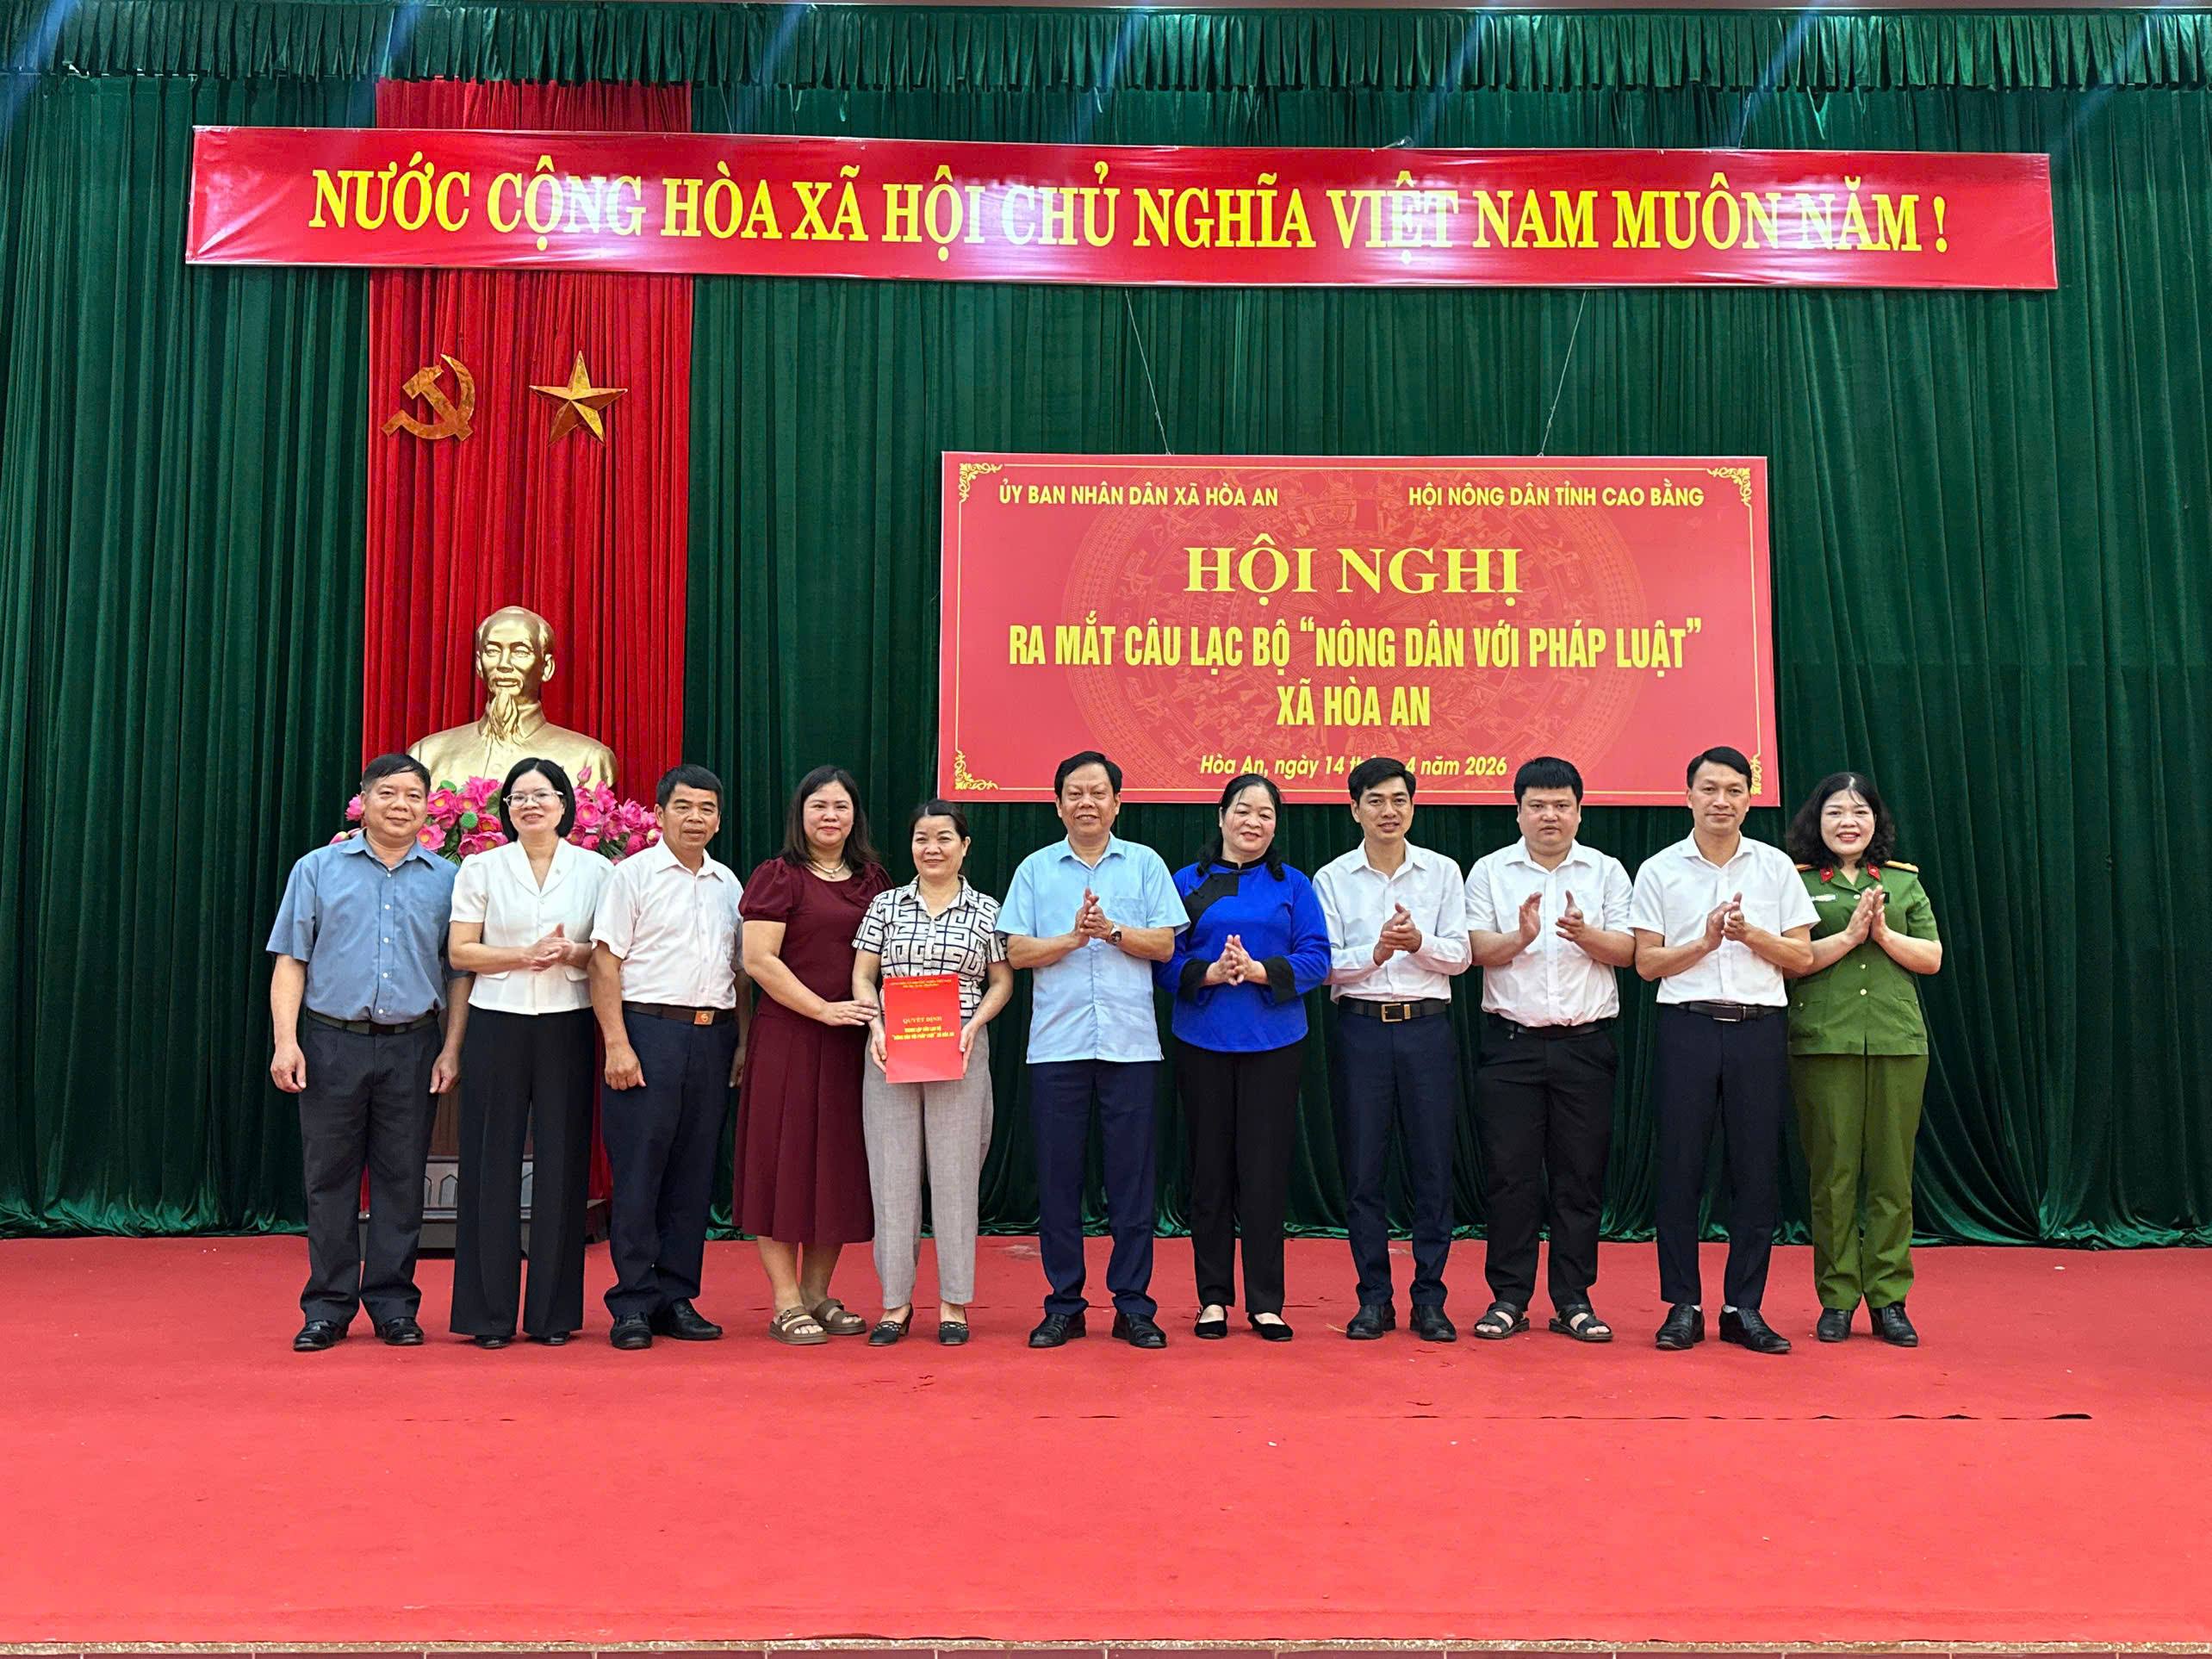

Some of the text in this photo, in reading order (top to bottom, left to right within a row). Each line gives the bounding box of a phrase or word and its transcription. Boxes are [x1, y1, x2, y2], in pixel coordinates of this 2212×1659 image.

[308, 151, 470, 232] NƯỚC
[487, 155, 647, 251] CỘNG
[660, 162, 783, 239] HÒA
[791, 165, 869, 241] XÃ
[882, 165, 986, 261] HỘI
[1001, 161, 1122, 247] CHỦ
[1132, 172, 1316, 248] NGHĨA
[1327, 171, 1459, 264] VIỆT
[1472, 190, 1599, 249] NAM
[1611, 172, 1780, 251] MUÔN
[1801, 176, 1922, 252] NĂM
[999, 478, 1278, 506] ỦY BAN NHÂN DÂN XÃ HÒA AN
[1408, 477, 1704, 511] HỘI NÔNG DÂN TỈNH CAO BẰNG
[1183, 533, 1523, 606] HỘI NGHỊ
[1009, 624, 1047, 665] RA
[1054, 611, 1116, 666] MẮT
[1124, 617, 1182, 666] CÂU
[1190, 625, 1244, 675] LẠC
[1253, 618, 1290, 676] BỘ
[1405, 618, 1465, 668] DÂN
[1473, 618, 1519, 668] VỚI
[1528, 618, 1607, 668] PHÁP
[1276, 675, 1431, 727] XÃ HÒA AN
[1200, 755, 1236, 774] Hòa
[1240, 755, 1269, 778] An,
[1275, 755, 1320, 780] ngày
[1326, 756, 1345, 774] 14
[1420, 755, 1459, 775] năm
[1464, 756, 1507, 776] 2026
